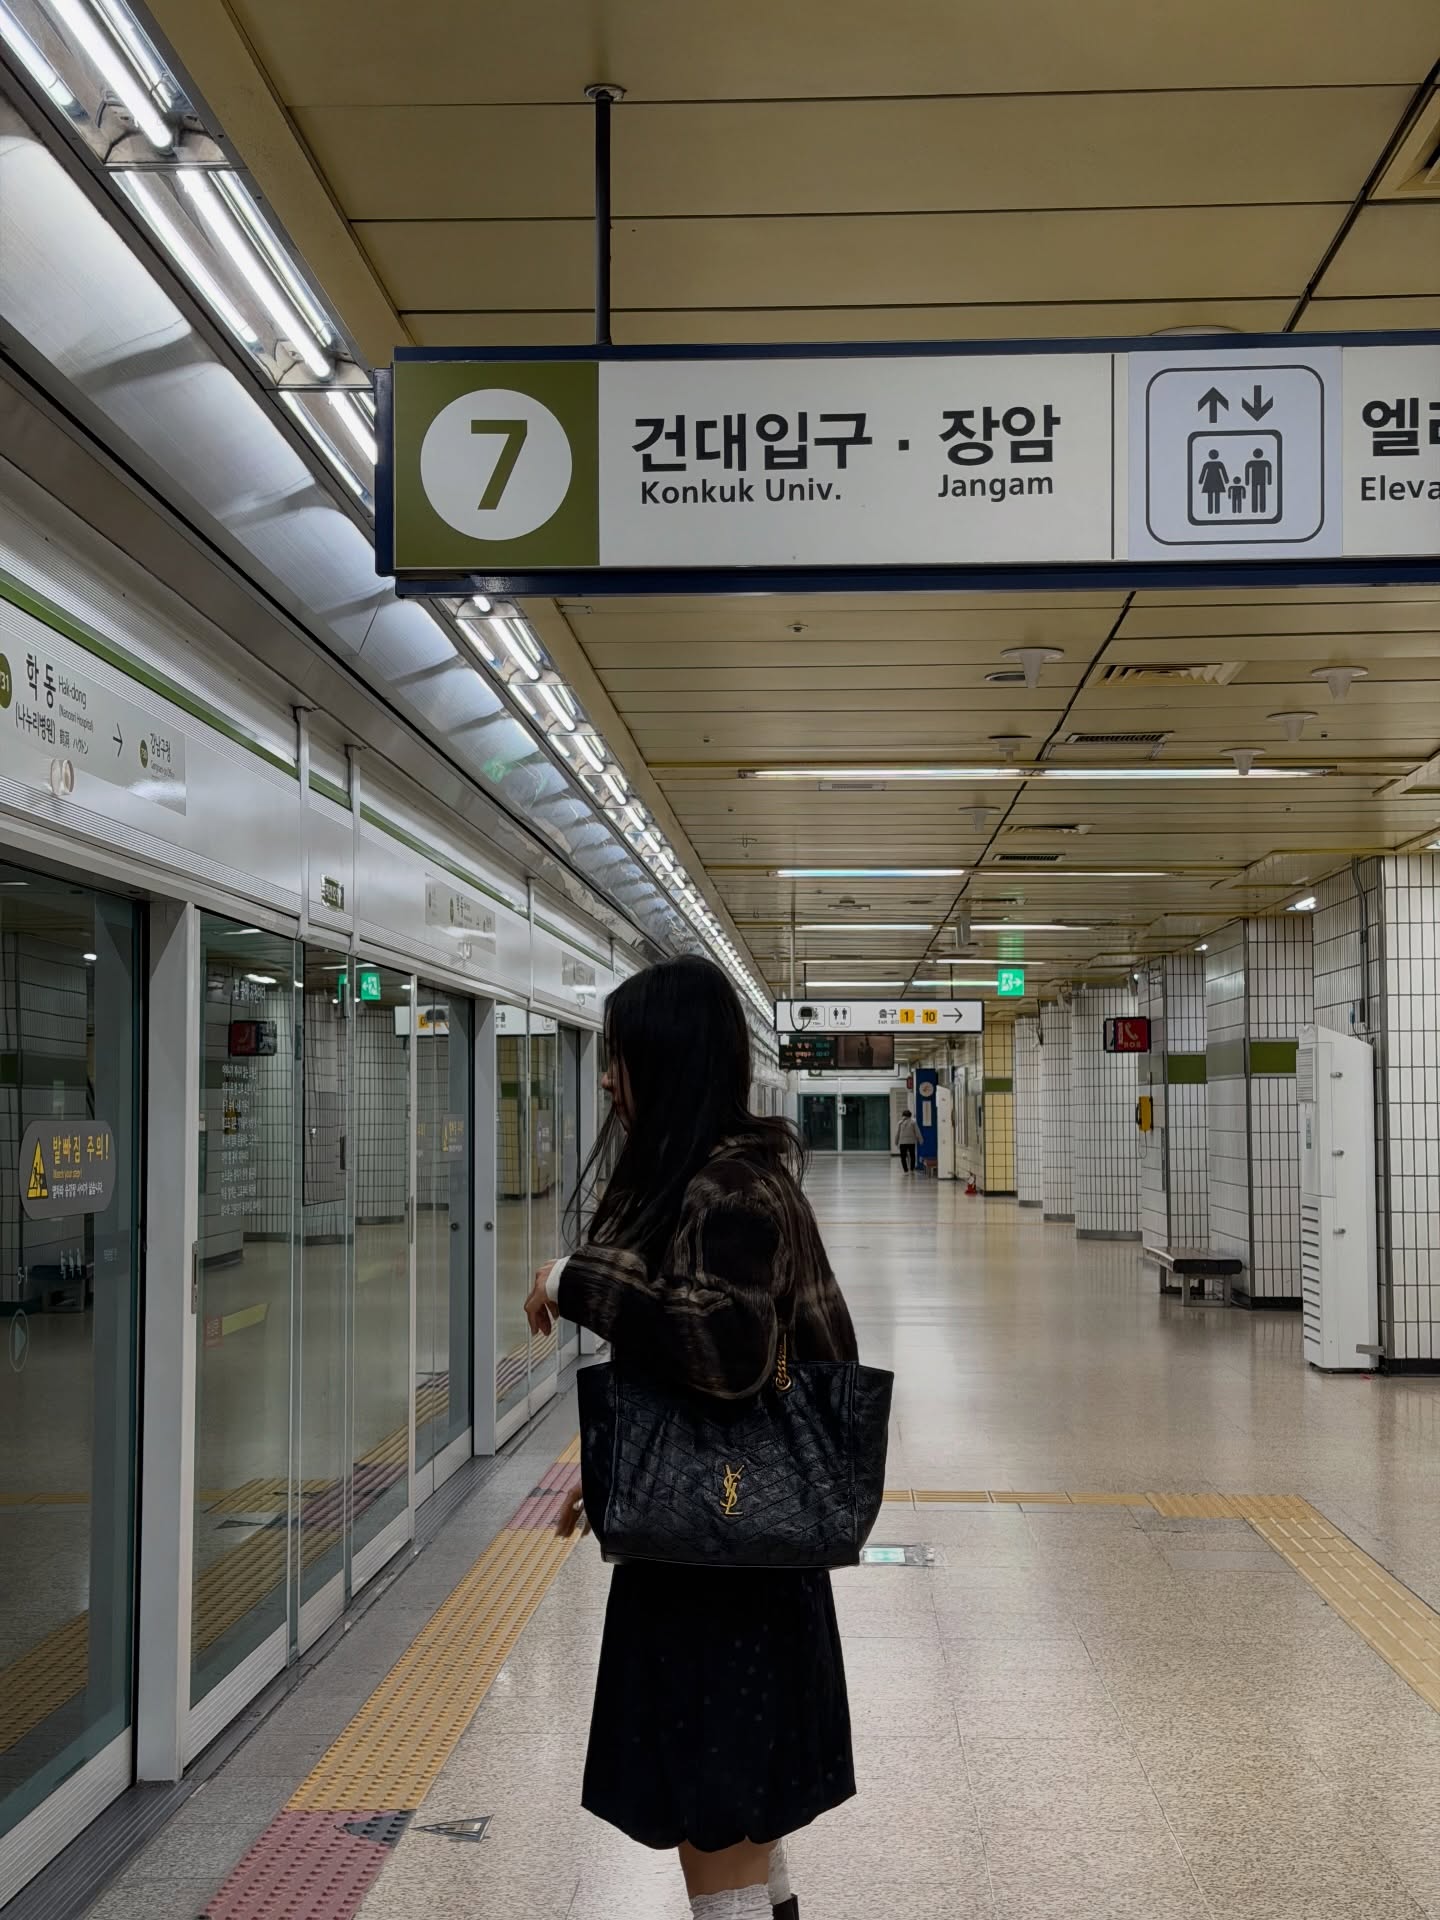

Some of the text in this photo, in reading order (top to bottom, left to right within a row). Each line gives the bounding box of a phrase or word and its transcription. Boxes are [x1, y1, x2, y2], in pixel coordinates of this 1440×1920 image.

[632, 412, 872, 472] 건대입구
[939, 405, 1060, 466] 장암
[1363, 398, 1440, 456] 엘
[471, 420, 527, 509] 7
[642, 475, 1052, 504] Konkuk Univ. Jangam
[59, 676, 87, 710] Hak-dong
[924, 1011, 936, 1022] 10
[53, 1133, 109, 1164] 발빠짐 주의!
